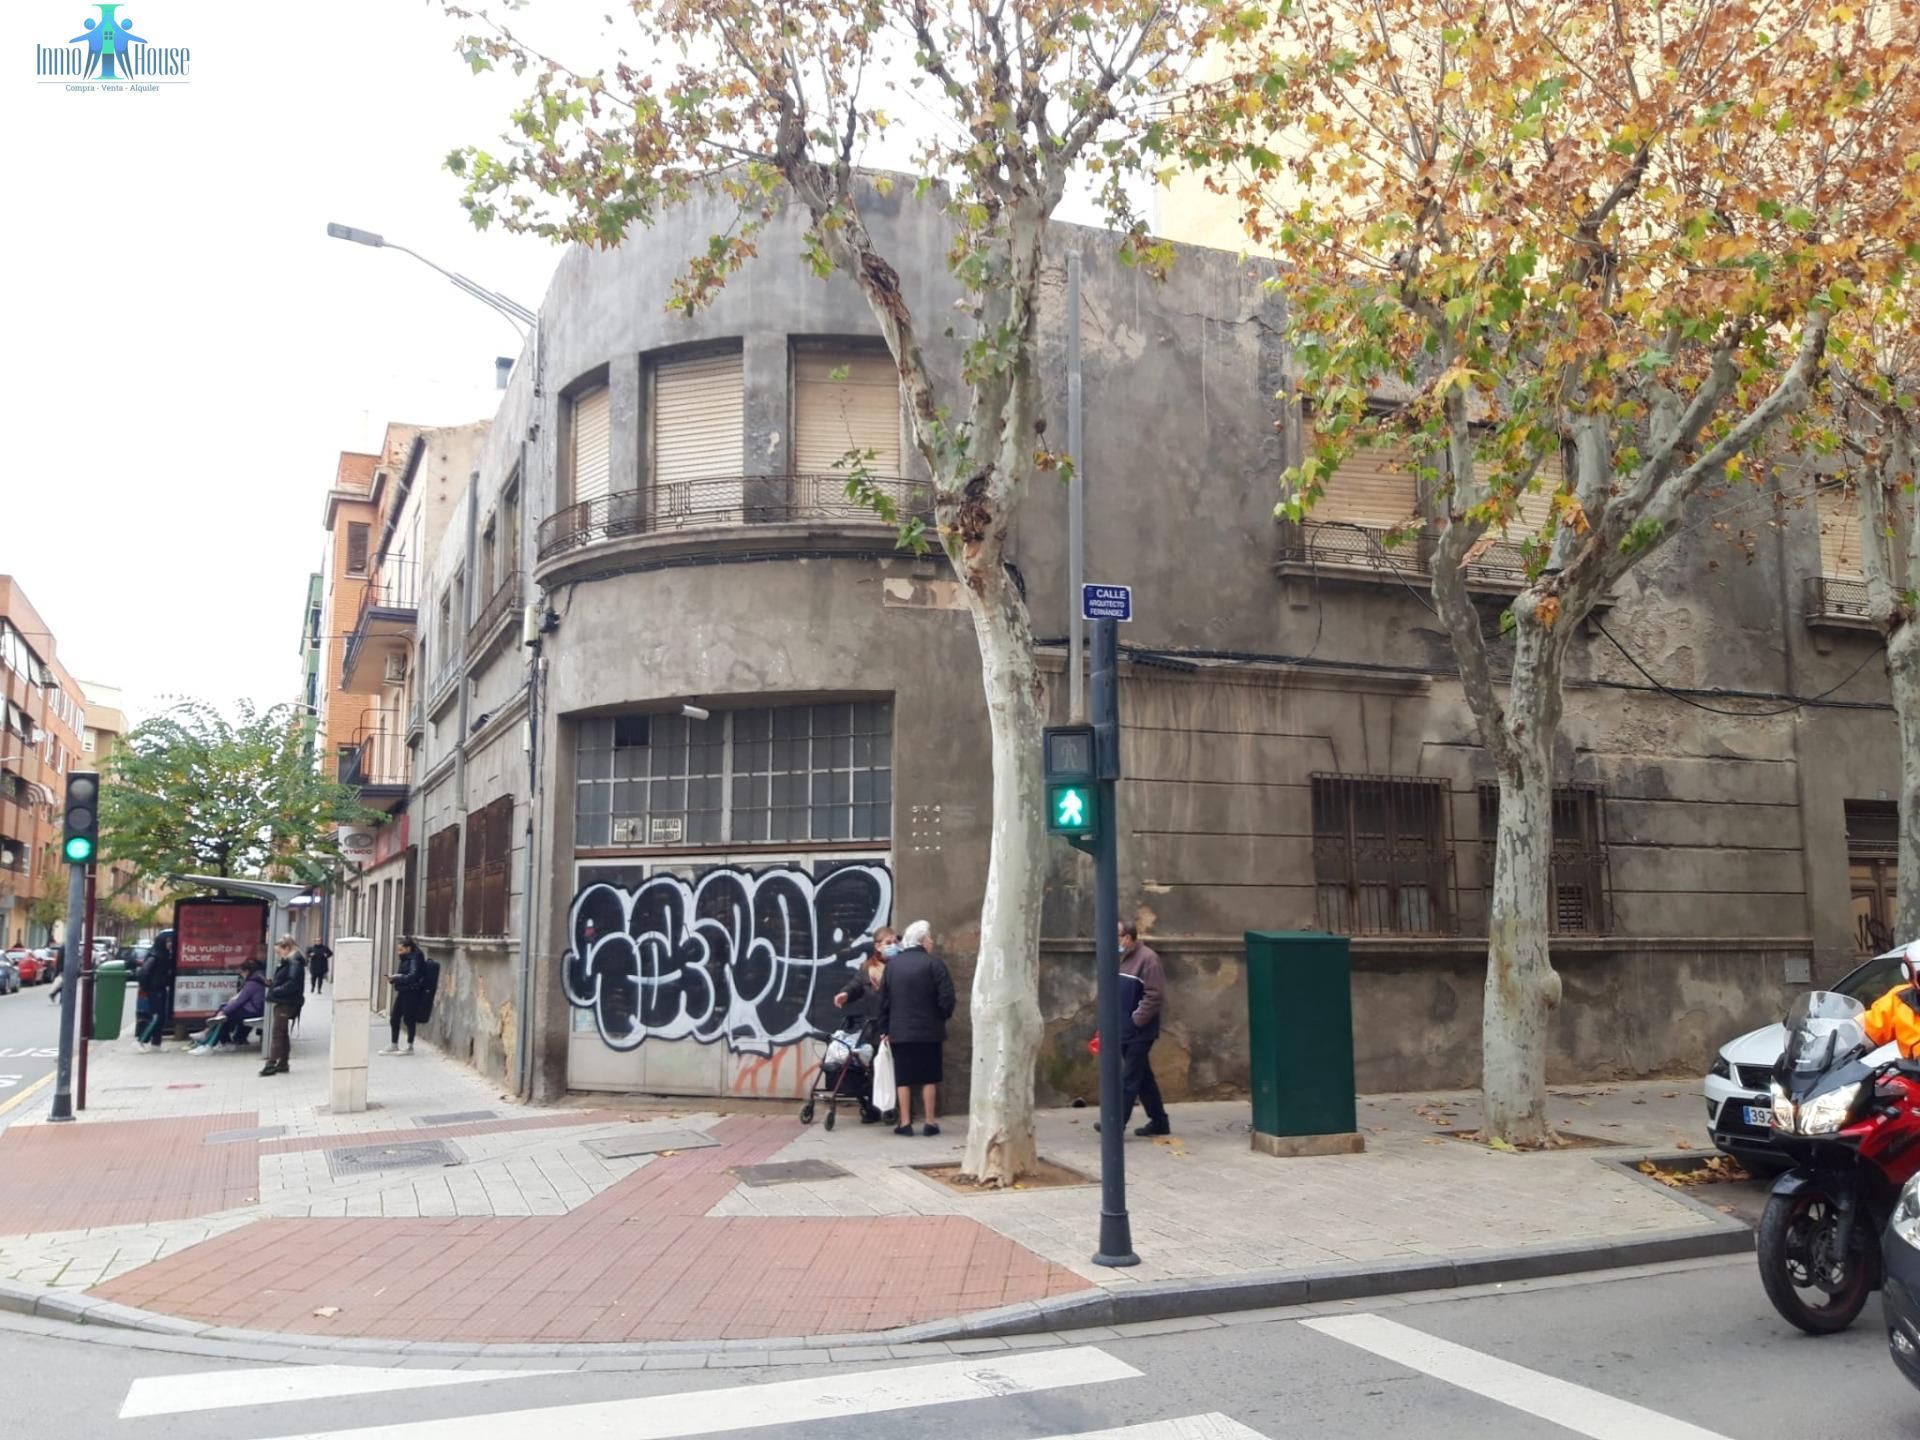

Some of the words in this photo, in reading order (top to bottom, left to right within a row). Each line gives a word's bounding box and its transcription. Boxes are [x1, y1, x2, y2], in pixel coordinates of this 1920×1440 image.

[1097, 589, 1126, 599] CALLE
[1089, 600, 1125, 608] ARQUITECTO
[182, 943, 196, 953] Ha
[199, 943, 232, 953] vuelto
[181, 953, 215, 962] hacer.
